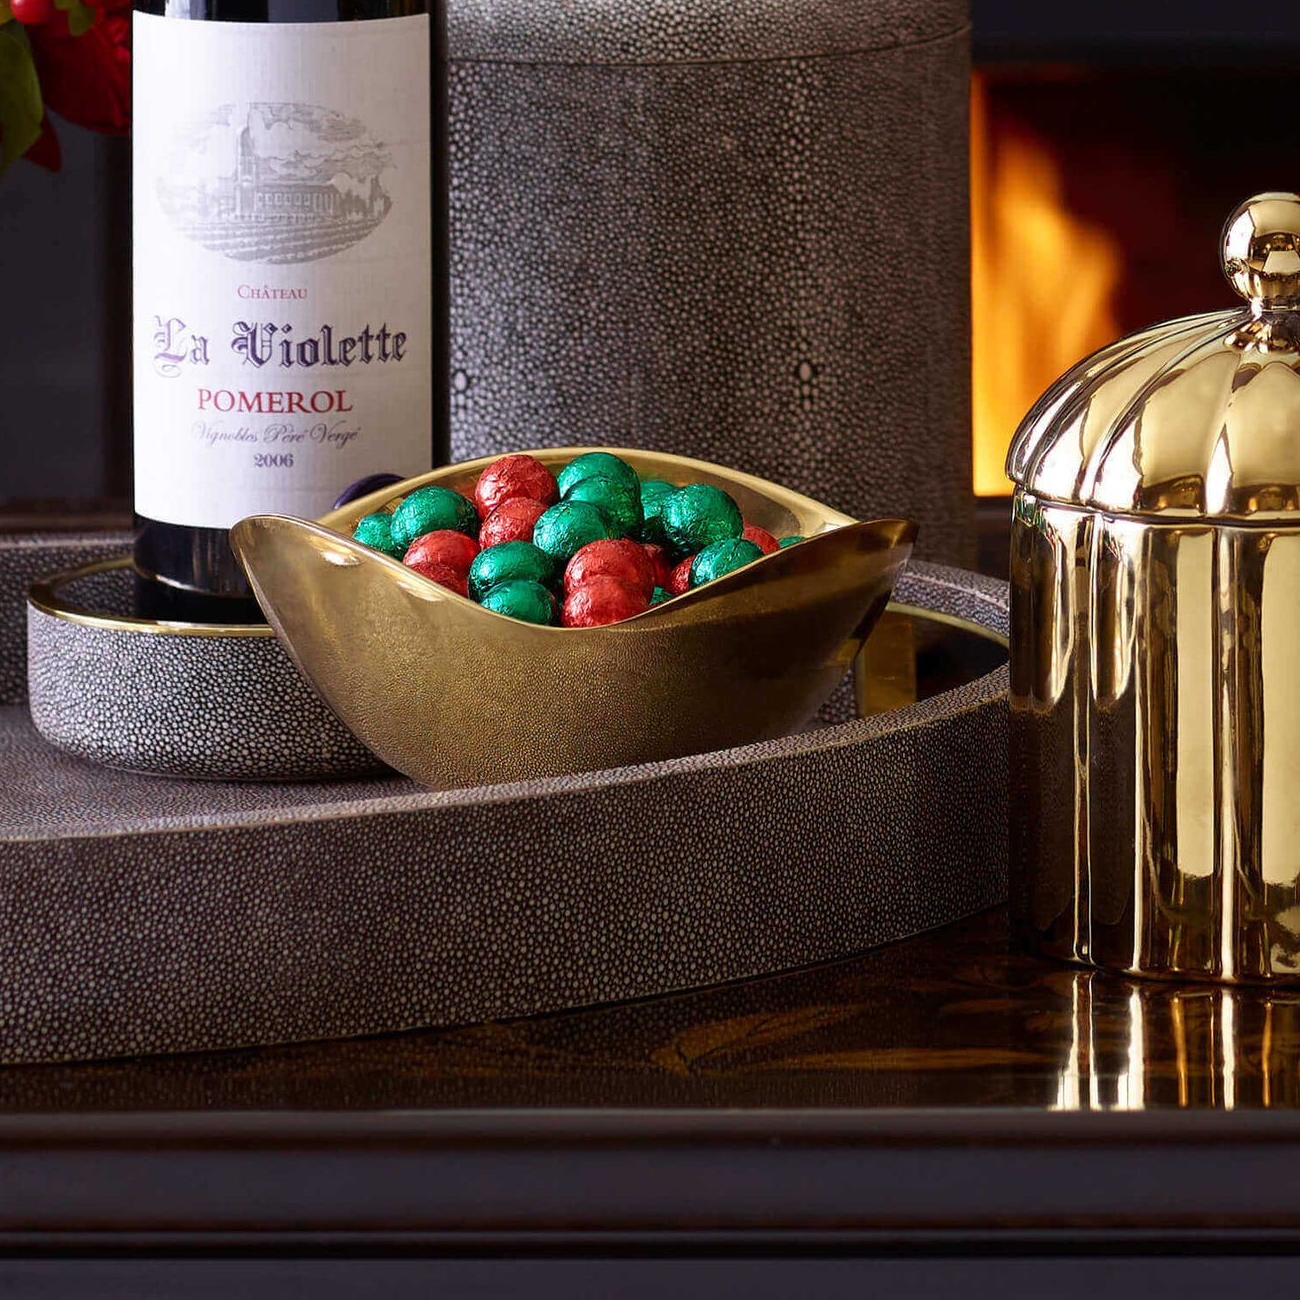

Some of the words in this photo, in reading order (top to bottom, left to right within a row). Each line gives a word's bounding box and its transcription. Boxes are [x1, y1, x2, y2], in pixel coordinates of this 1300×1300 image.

[153, 315, 210, 378] La
[231, 321, 407, 369] Violette
[197, 388, 353, 414] POMEROL
[191, 420, 258, 447] Vignobles
[253, 453, 294, 468] 2006
